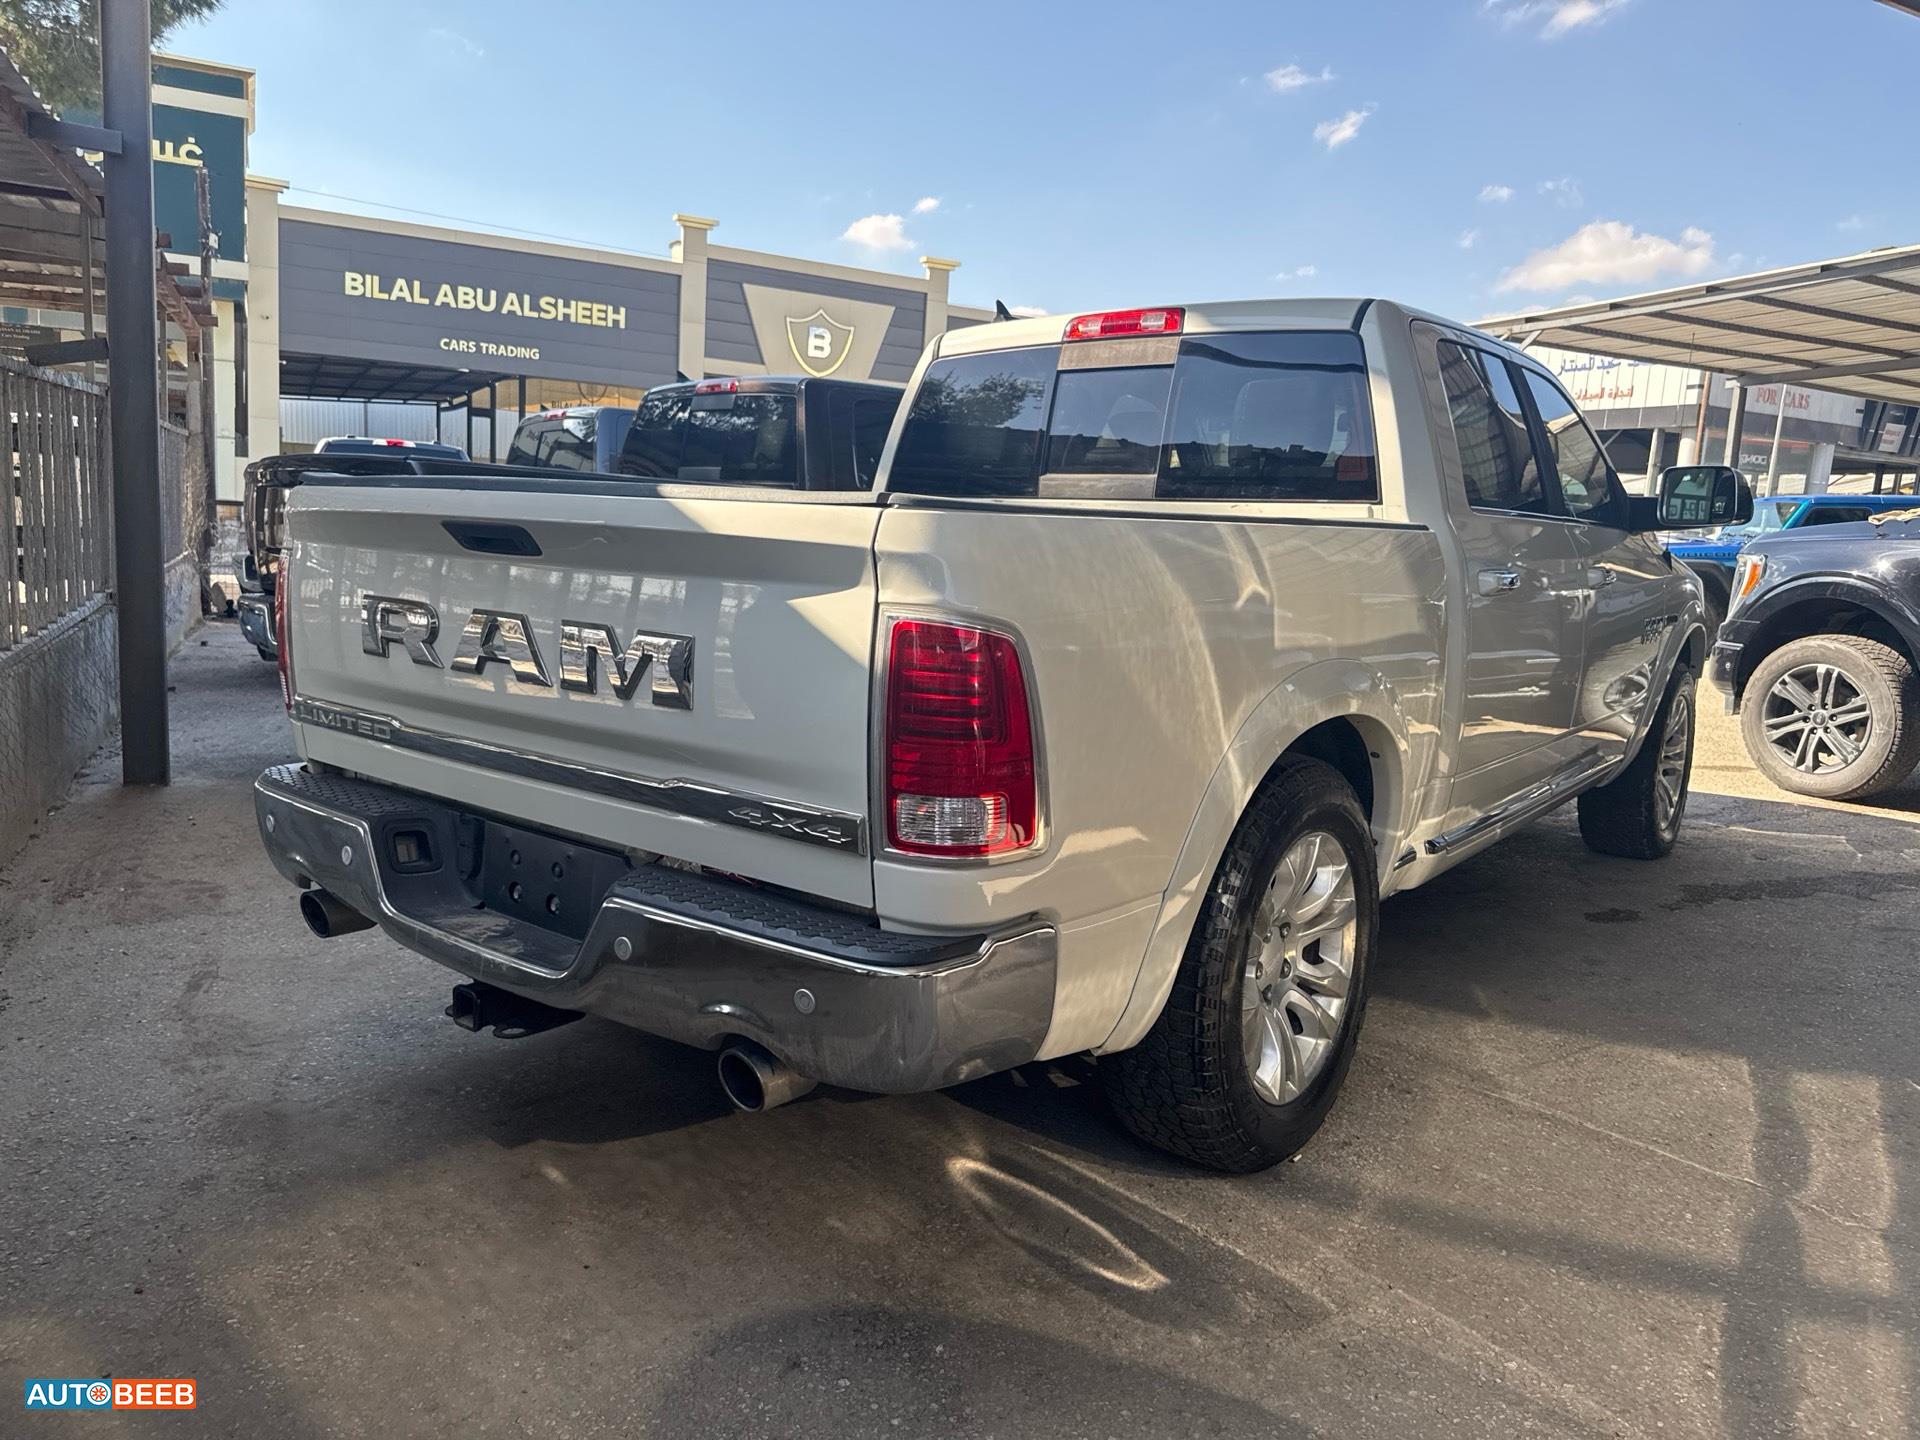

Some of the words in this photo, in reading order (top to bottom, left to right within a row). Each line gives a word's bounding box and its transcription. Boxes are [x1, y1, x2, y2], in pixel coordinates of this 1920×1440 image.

[344, 271, 430, 305] BILAL
[434, 284, 498, 312] ABU
[501, 292, 627, 329] ALSHEEH
[440, 338, 477, 353] CARS
[480, 342, 540, 360] TRADING
[807, 325, 832, 359] B
[1756, 386, 1777, 405] FOR
[1784, 391, 1810, 409] CARS
[361, 594, 696, 711] RAM
[300, 705, 392, 740] LIMITED
